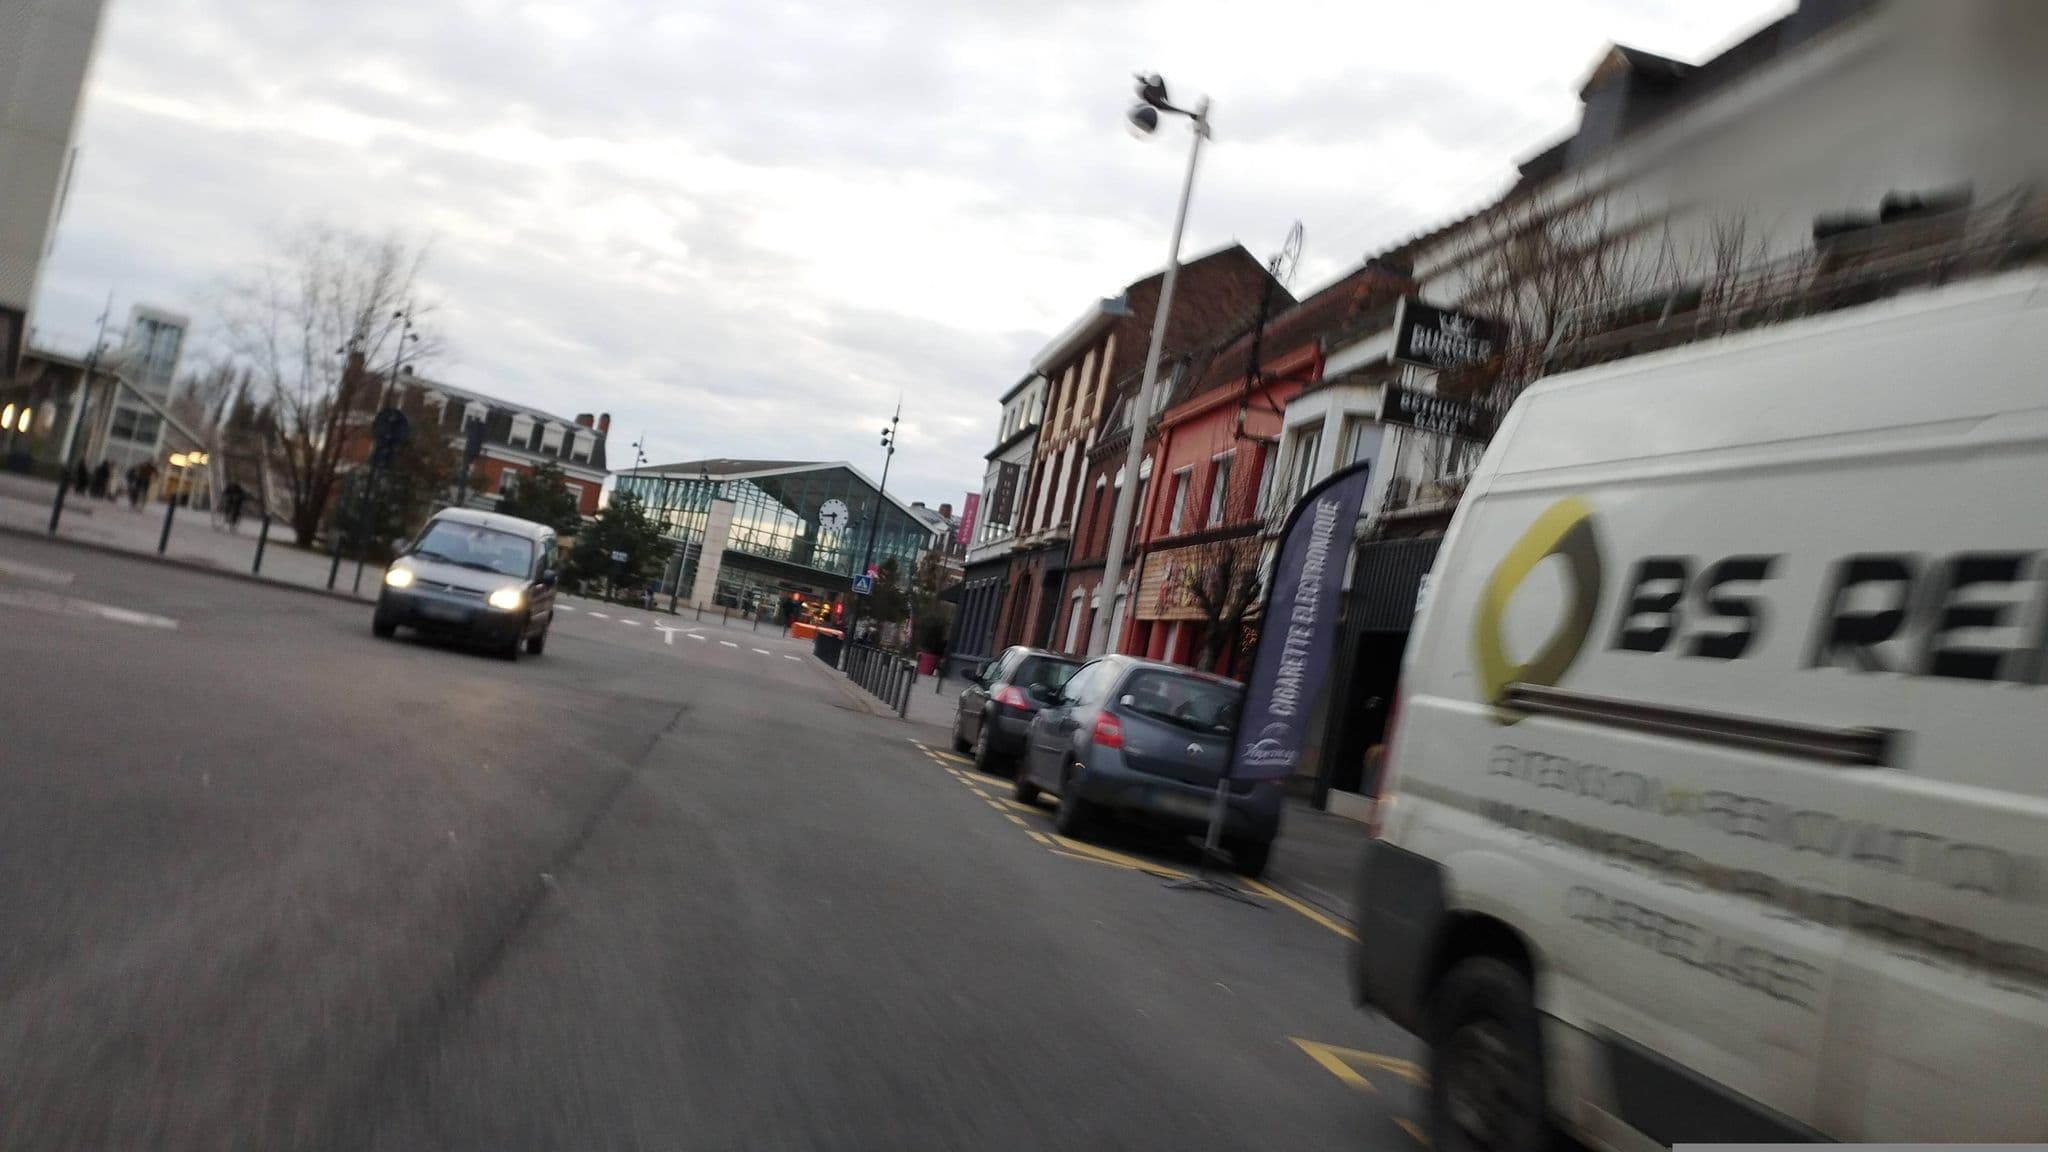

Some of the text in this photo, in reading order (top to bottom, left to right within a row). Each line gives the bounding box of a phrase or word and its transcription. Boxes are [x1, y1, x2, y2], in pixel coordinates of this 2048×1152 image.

[1409, 323, 1494, 364] BURGER
[1268, 623, 1315, 716] CIGARETTE
[1293, 499, 1340, 624] ELECTRONIQUE
